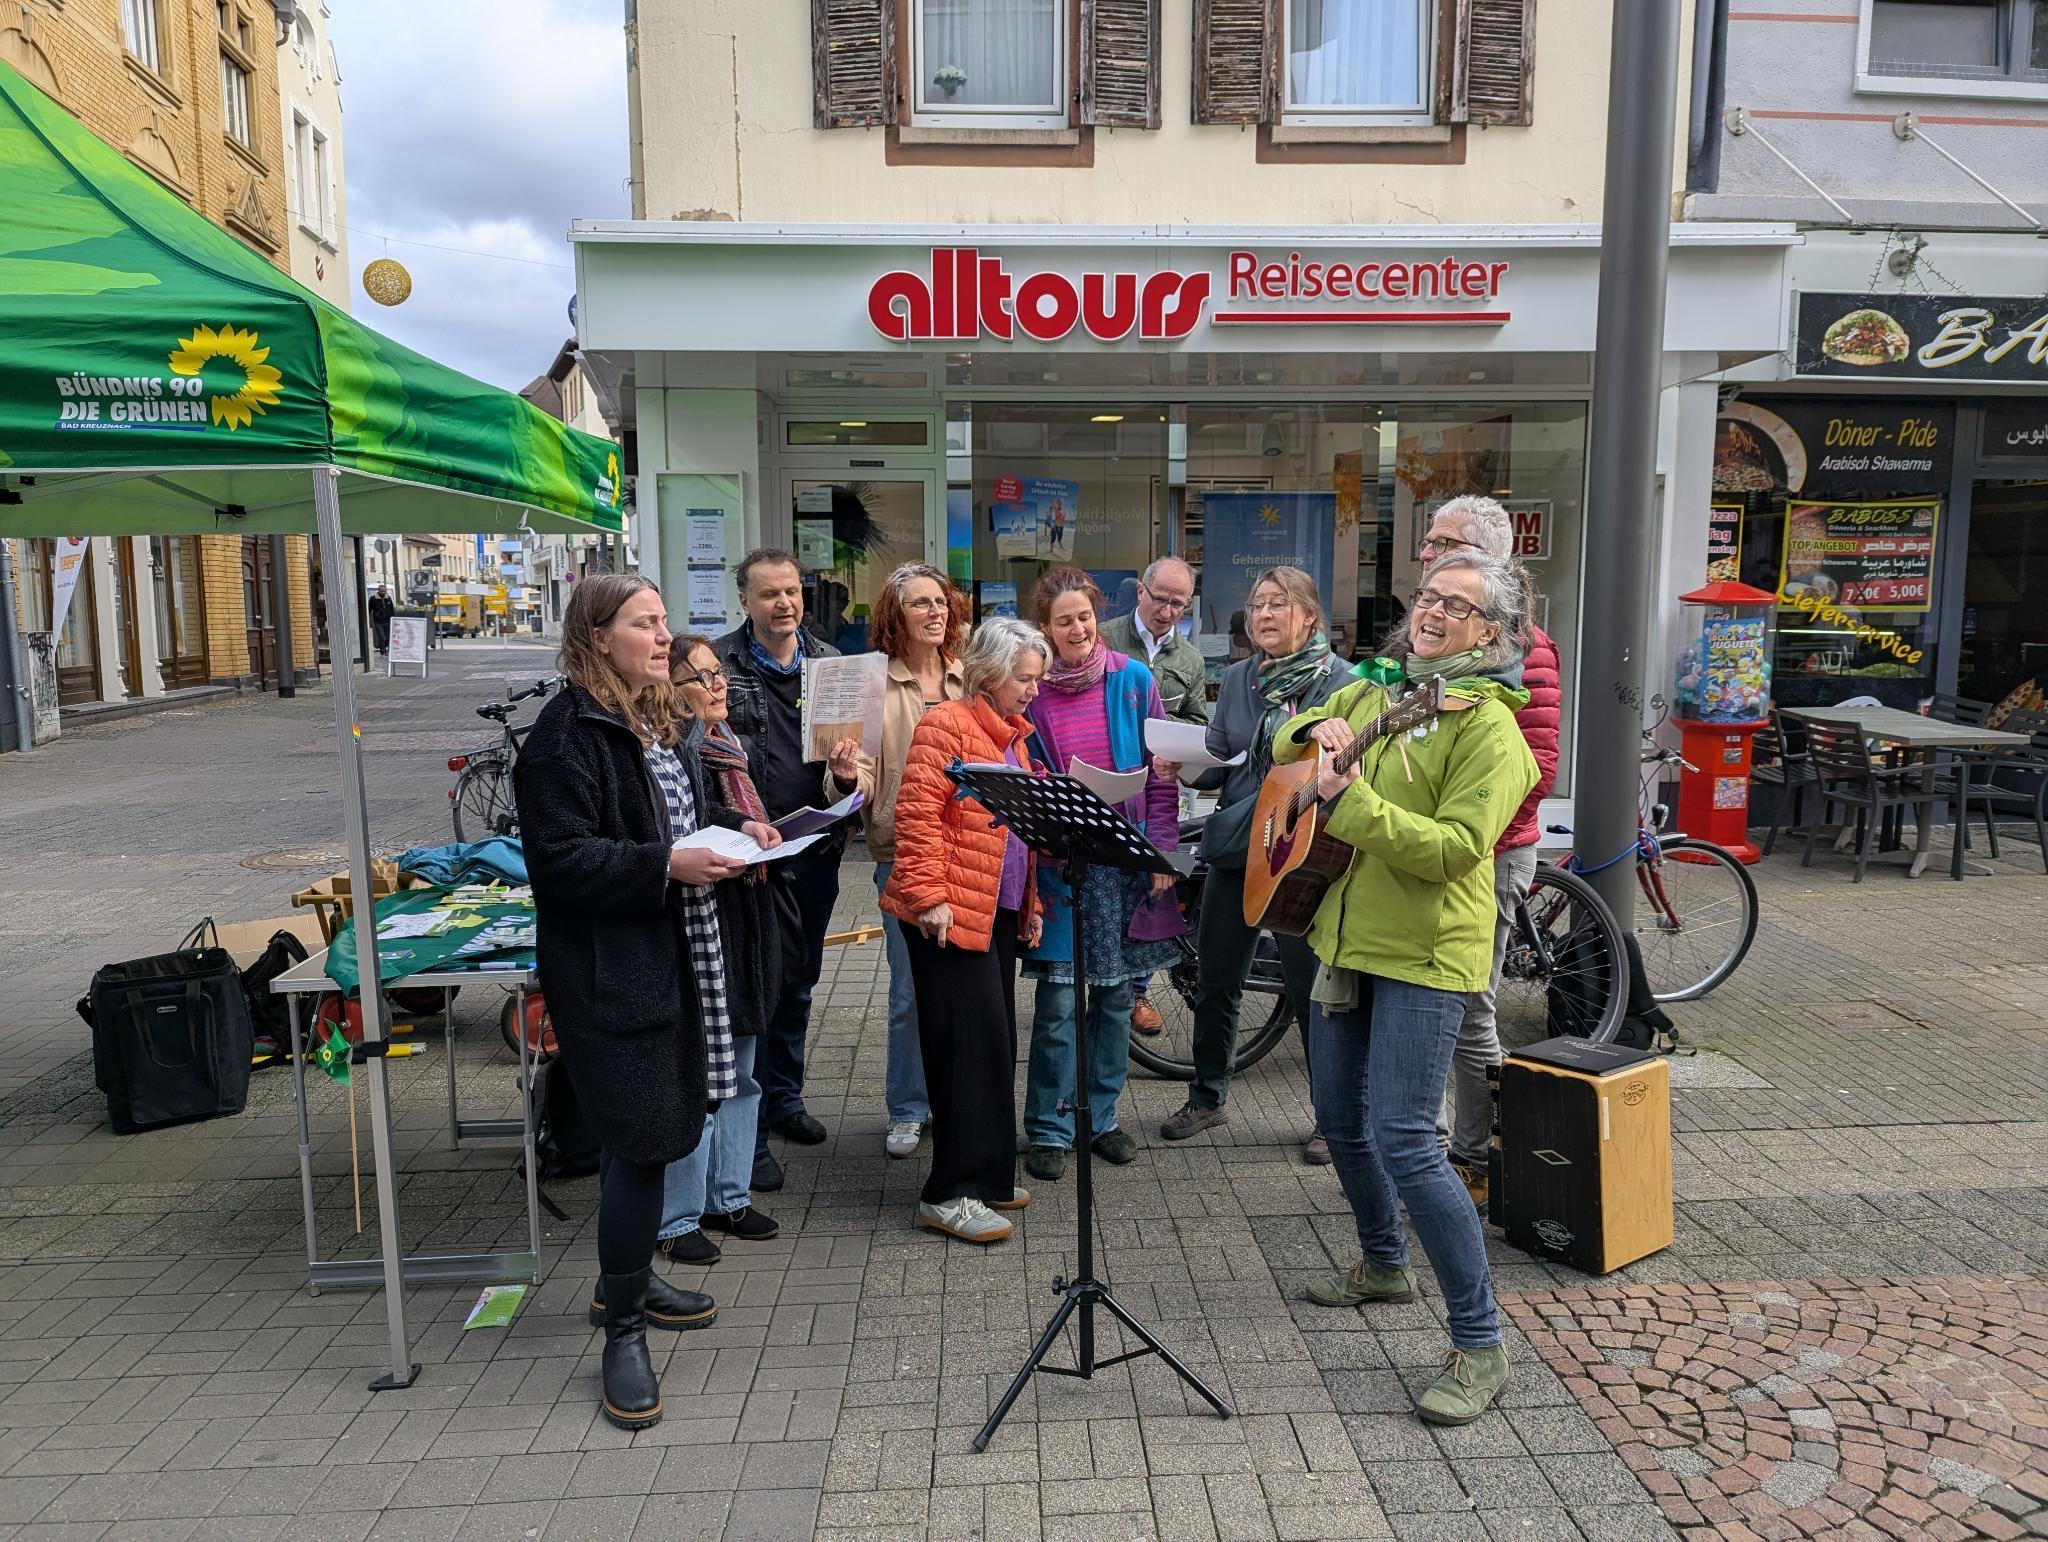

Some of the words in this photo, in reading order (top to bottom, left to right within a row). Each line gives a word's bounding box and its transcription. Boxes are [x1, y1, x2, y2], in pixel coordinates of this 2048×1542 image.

[868, 248, 1211, 341] alltours
[1228, 251, 1509, 300] Reisecenter
[1918, 308, 2048, 368] BA
[56, 372, 162, 397] BÜNDNIS
[170, 377, 203, 397] 90
[60, 401, 100, 420] DIE
[110, 397, 207, 422] GRÜNEN
[1825, 418, 1883, 447] Döner
[1898, 418, 1938, 448] Pide
[1819, 455, 1870, 470] Arabisch
[1872, 456, 1932, 470] Shawarma
[1710, 509, 1738, 521] izza
[1827, 508, 1914, 524] BABOSS
[1707, 545, 1737, 555] enstag
[1791, 540, 1813, 551] TOP
[1813, 541, 1857, 551] ANGEBOT
[1862, 540, 1896, 552] خاص
[1899, 540, 1930, 552] عرض
[1232, 553, 1304, 567] Geheimtipps
[1893, 555, 1926, 570] شاورما
[1889, 584, 1924, 599] 5,00€
[1776, 572, 1924, 664] Lieferservice
